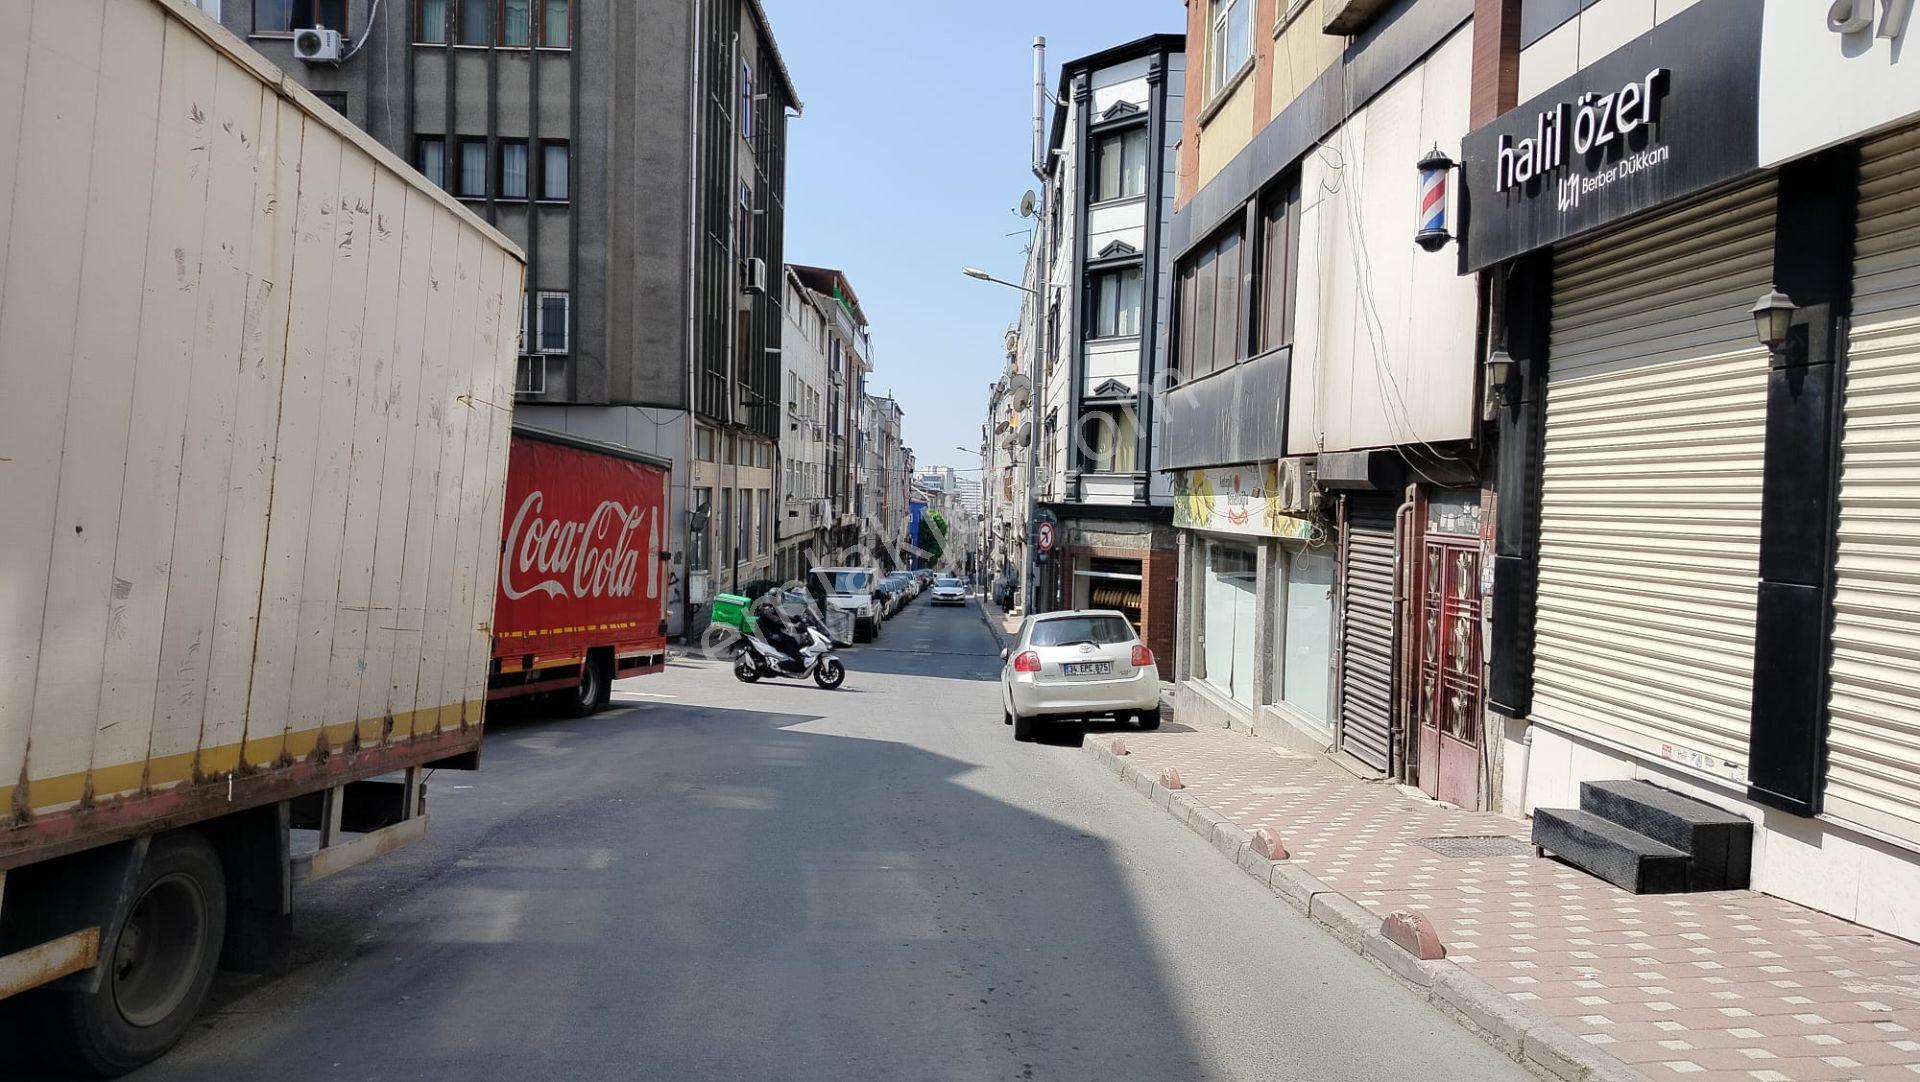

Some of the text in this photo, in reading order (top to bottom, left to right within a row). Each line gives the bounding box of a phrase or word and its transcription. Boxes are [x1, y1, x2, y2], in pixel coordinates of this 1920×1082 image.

[1496, 102, 1562, 192] halil
[1573, 67, 1660, 155] özer
[1581, 166, 1618, 195] Berber
[1619, 145, 1669, 179] Dükkanı
